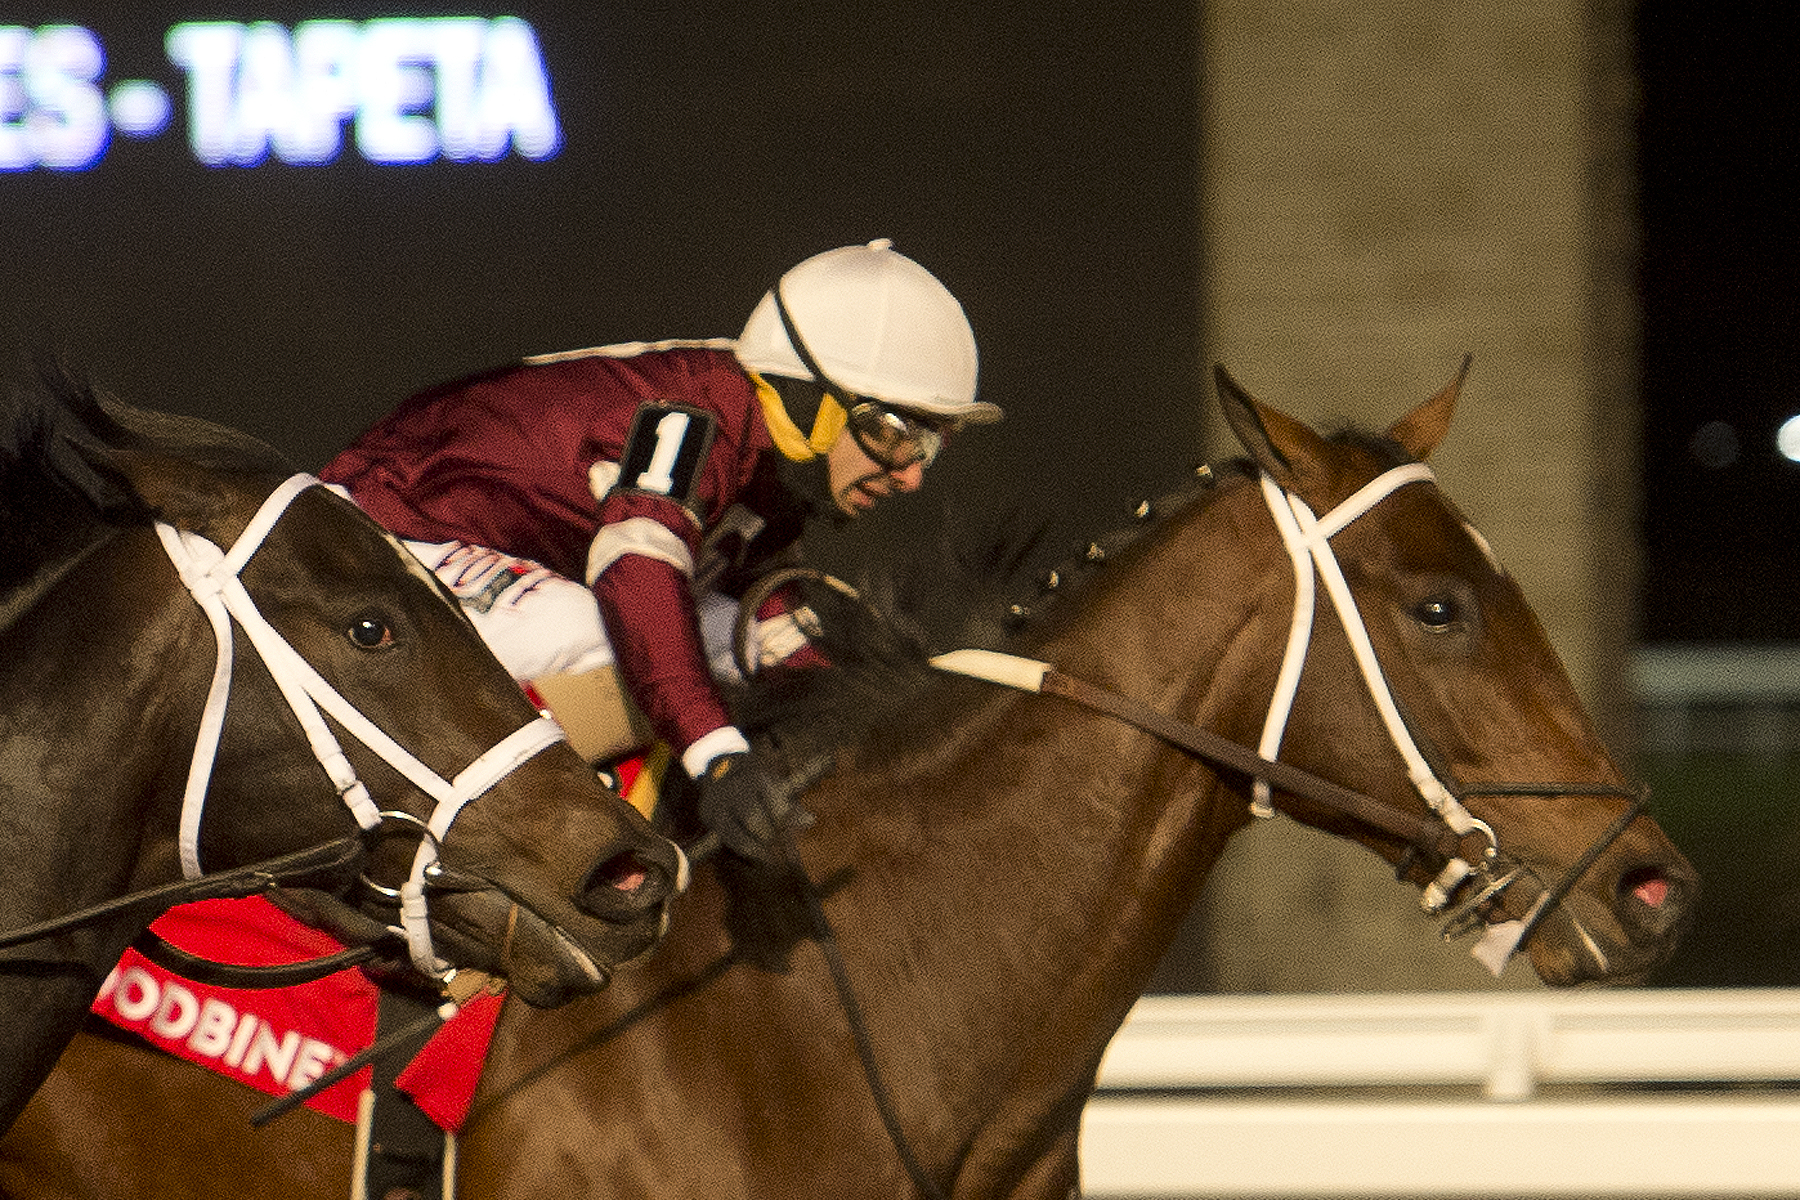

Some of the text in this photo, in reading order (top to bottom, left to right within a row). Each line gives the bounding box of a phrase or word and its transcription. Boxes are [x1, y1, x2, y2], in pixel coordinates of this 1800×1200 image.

[166, 16, 558, 163] TAPETA
[636, 412, 690, 494] 1
[98, 966, 334, 1092] ODBINE
